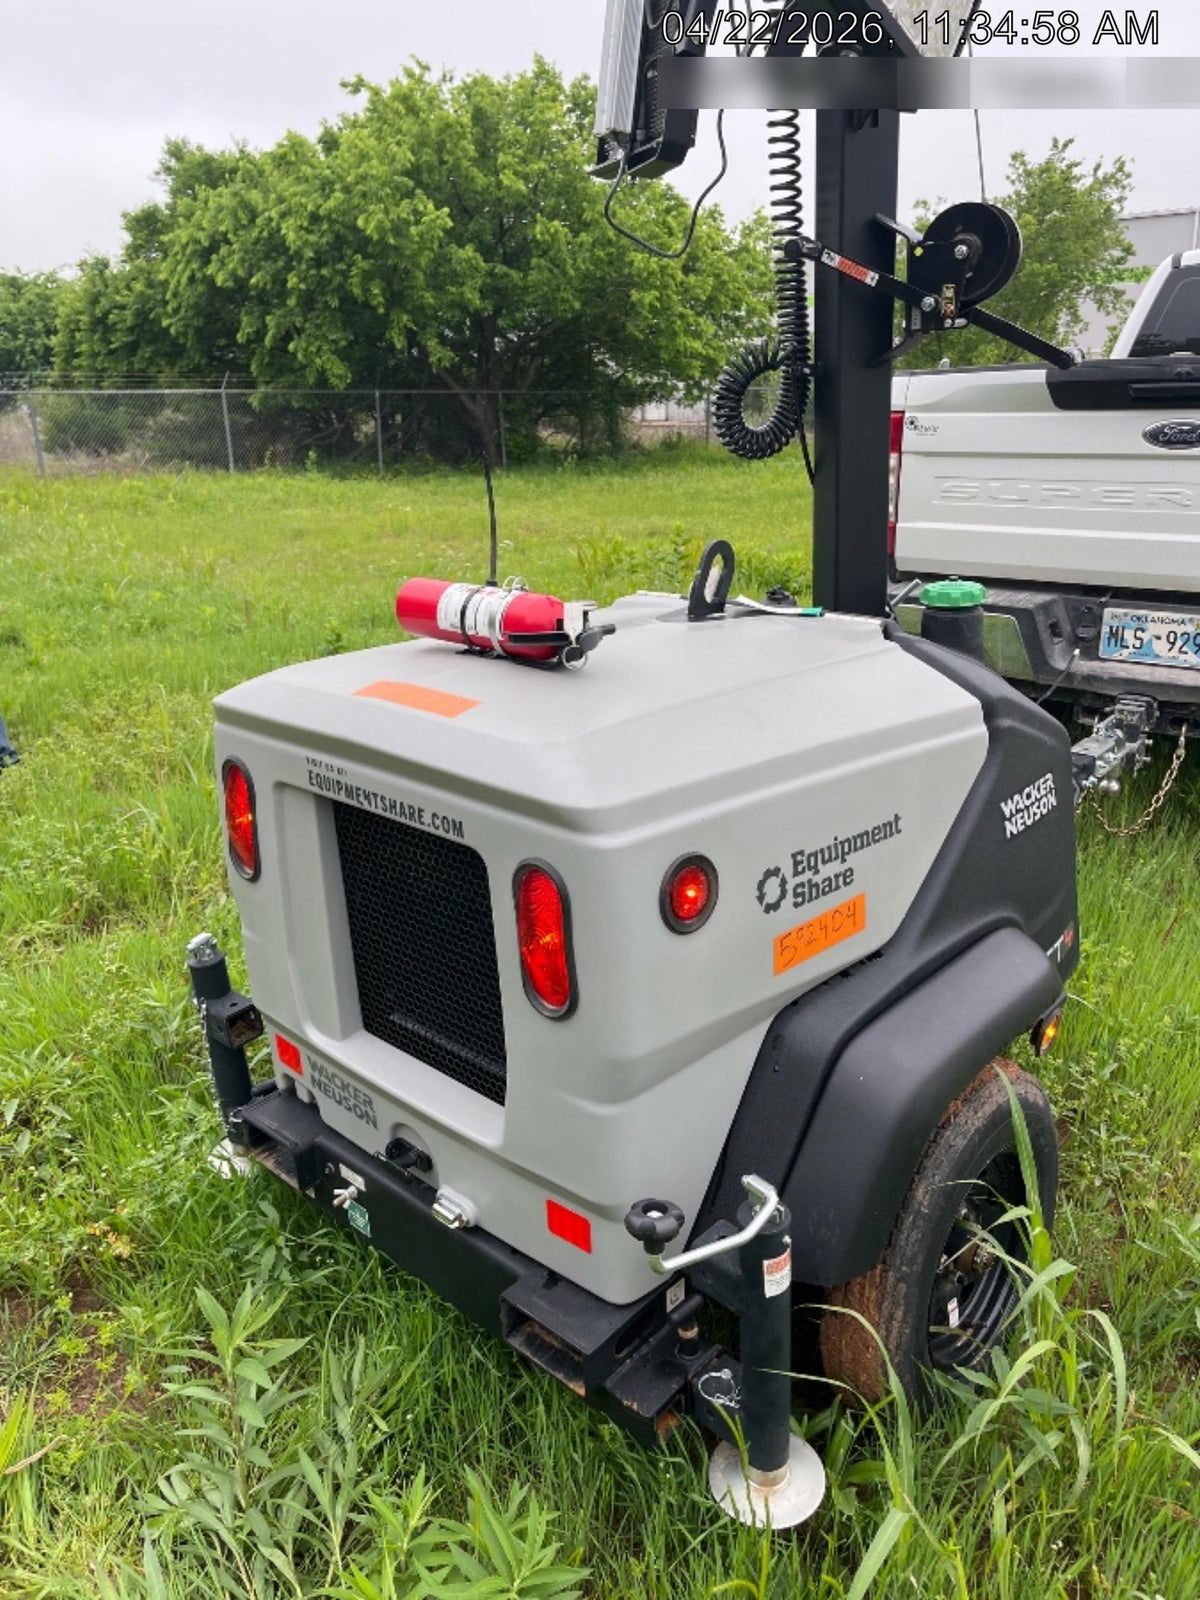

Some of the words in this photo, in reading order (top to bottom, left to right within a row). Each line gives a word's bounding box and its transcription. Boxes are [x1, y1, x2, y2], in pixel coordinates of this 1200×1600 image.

[1159, 424, 1200, 442] Ford
[1130, 614, 1187, 626] OKLAHOMA
[307, 769, 464, 840] EQUIPMENTSHARE.COM
[1000, 772, 1055, 819] WACKER
[1004, 788, 1057, 838] NEUSON
[790, 813, 902, 879] Equipment
[792, 867, 855, 909] Share
[306, 1054, 376, 1114] WACKER
[310, 1073, 379, 1131] NEUSON
